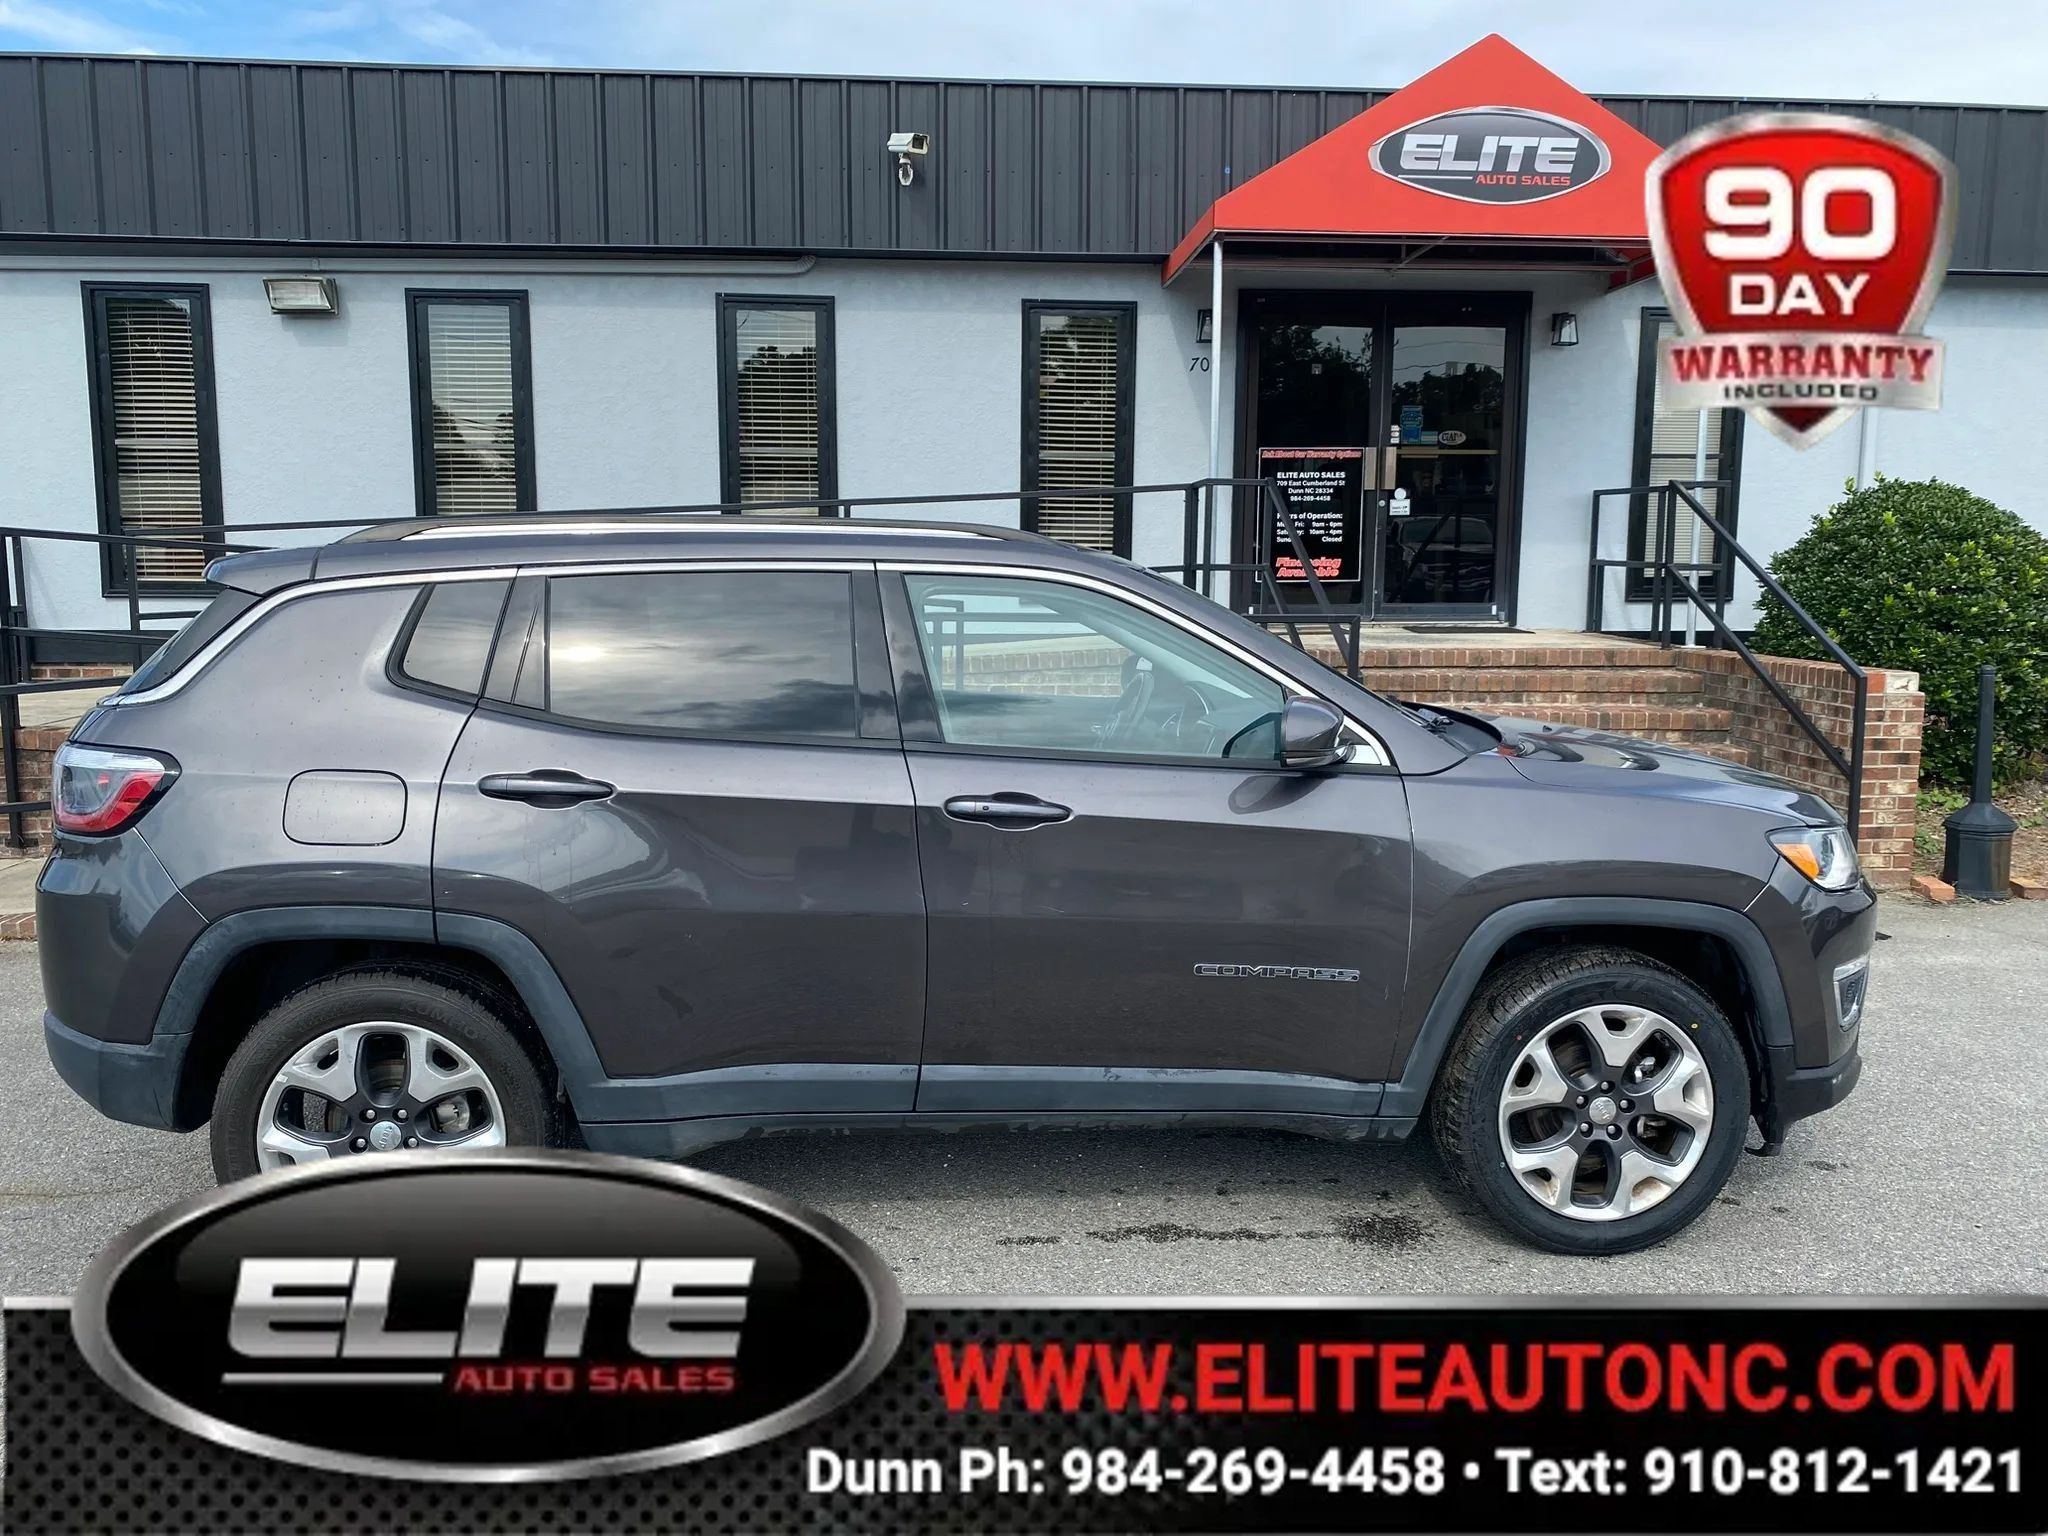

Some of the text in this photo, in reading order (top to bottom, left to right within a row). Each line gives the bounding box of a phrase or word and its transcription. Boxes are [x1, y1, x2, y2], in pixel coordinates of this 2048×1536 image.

[1399, 133, 1580, 174] ELITE
[1475, 174, 1571, 187] AUTO SALES
[1276, 471, 1346, 479] ELITE AUTO SALES
[1306, 512, 1343, 520] Operation:
[1193, 963, 1361, 982] COMPASS
